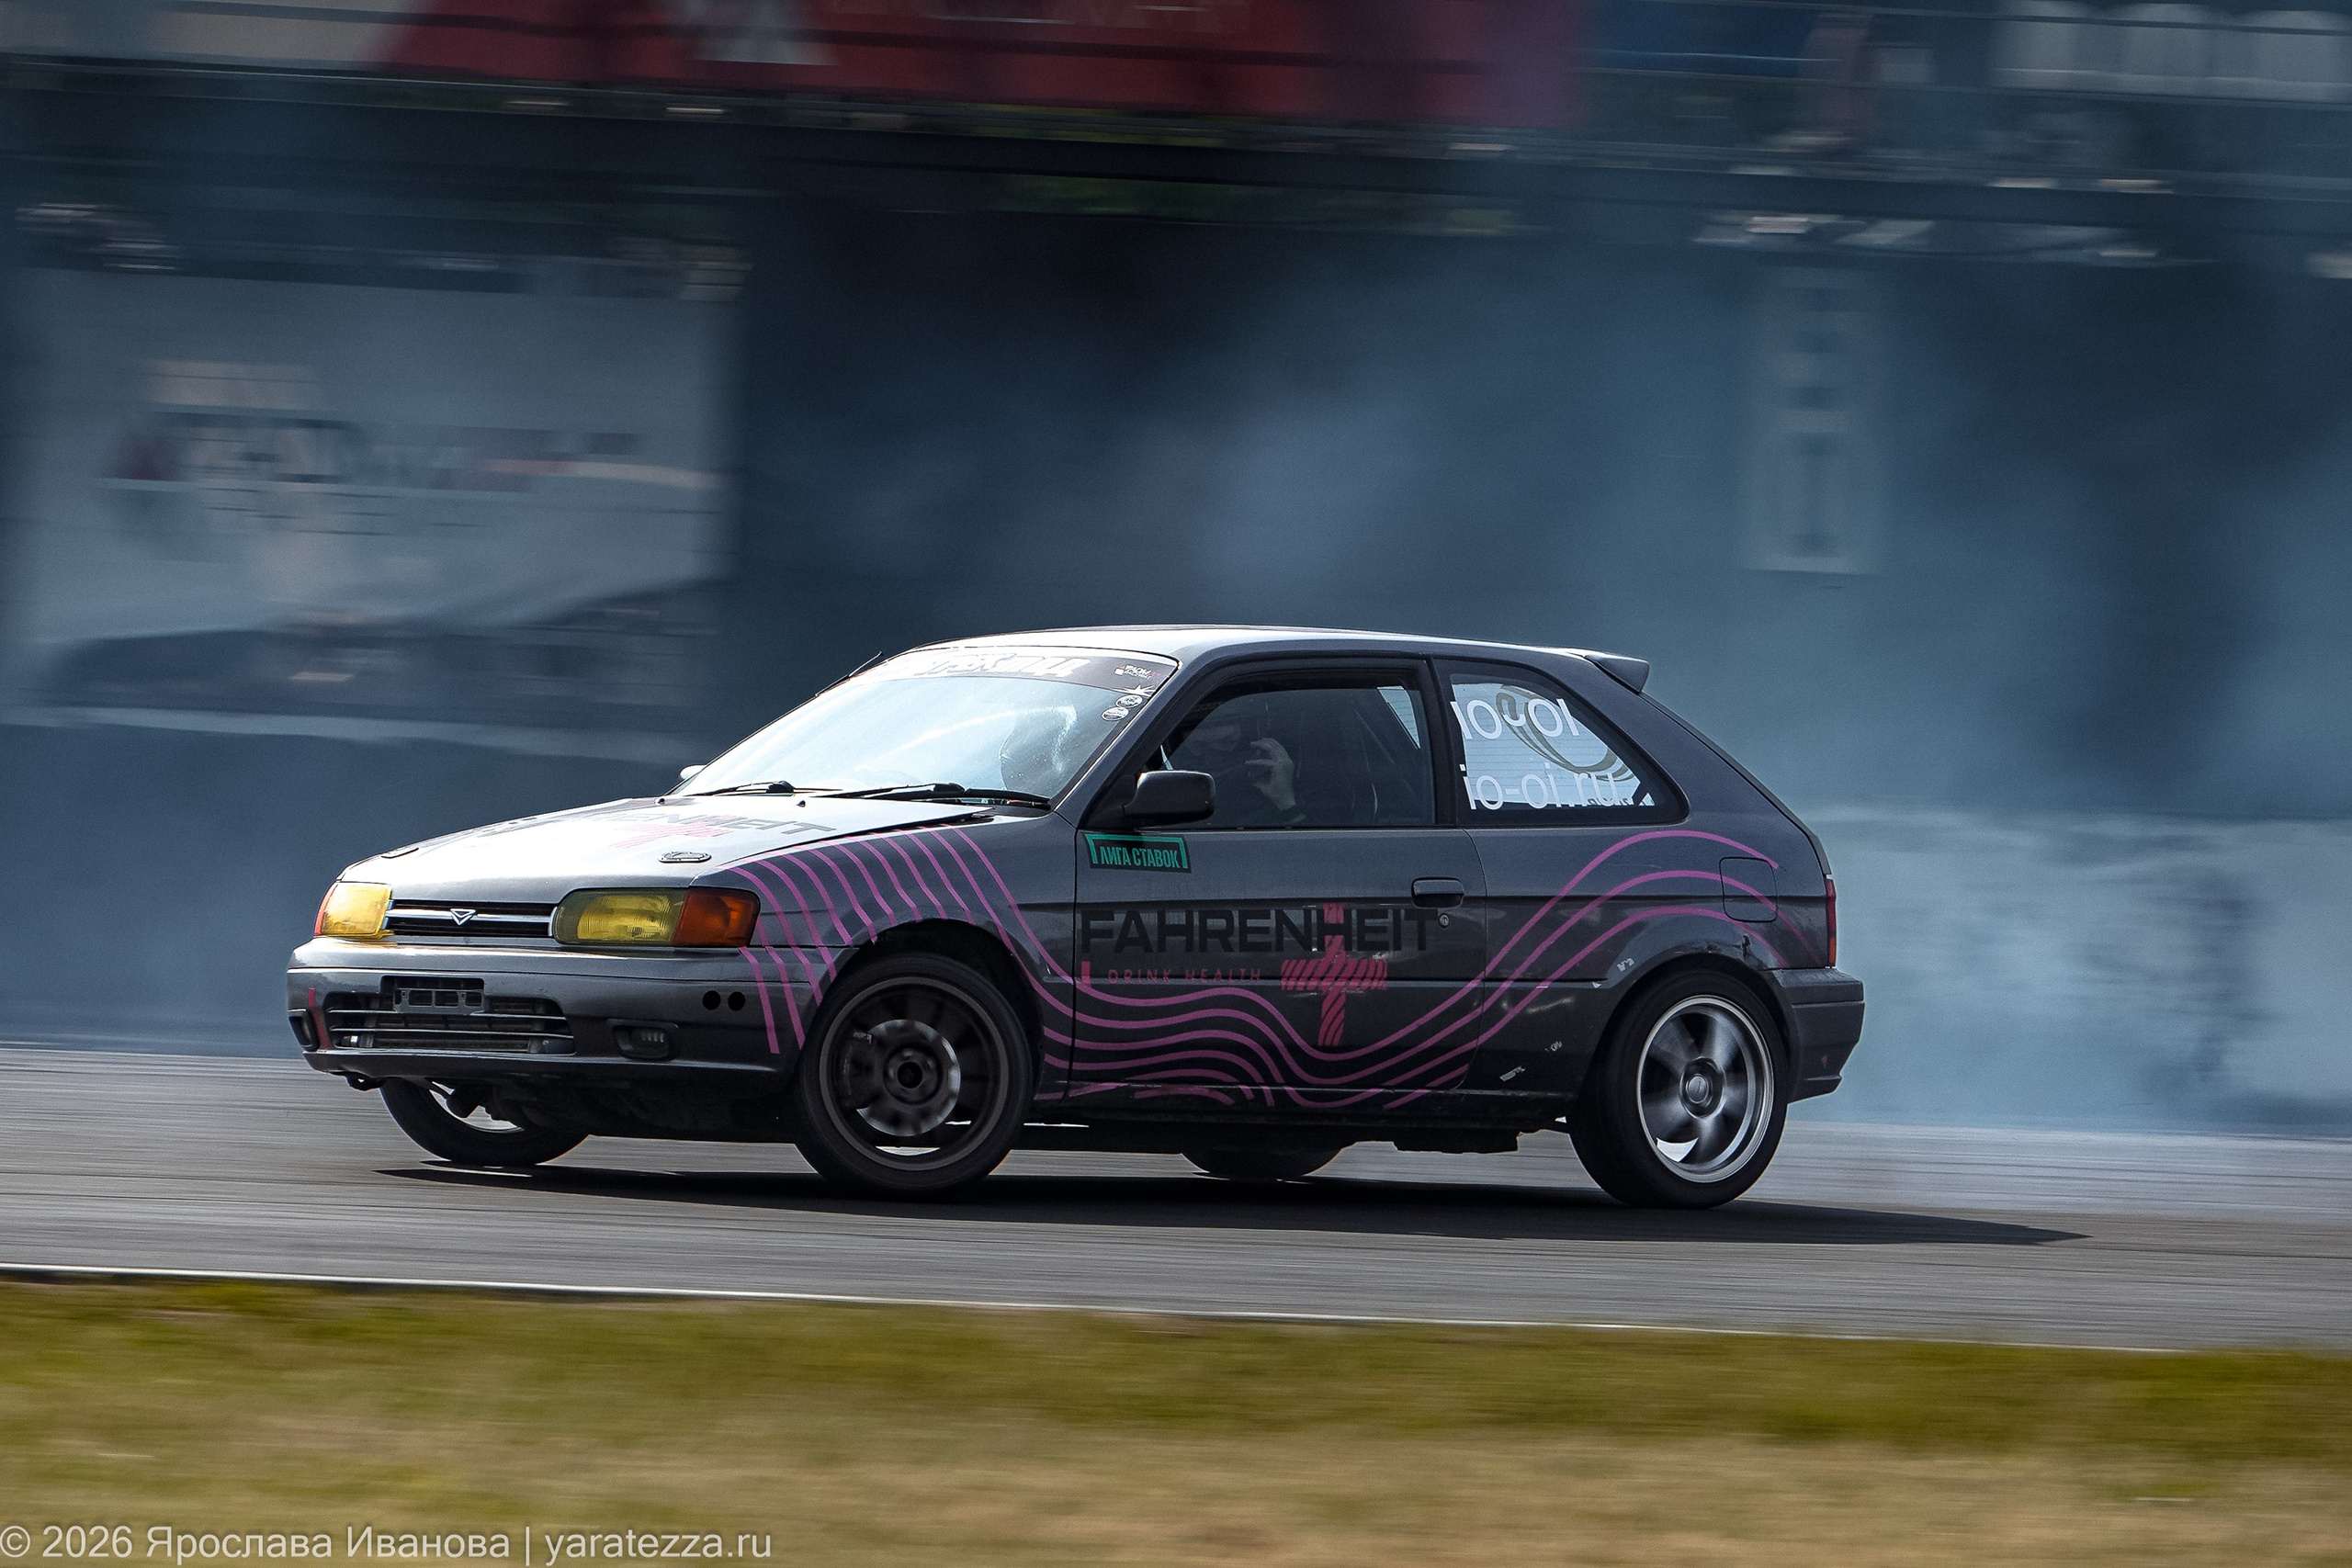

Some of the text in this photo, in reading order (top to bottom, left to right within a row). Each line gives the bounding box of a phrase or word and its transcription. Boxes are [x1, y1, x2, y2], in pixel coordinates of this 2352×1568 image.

[1100, 846, 1181, 869] ЛИГА СТАВОК
[1080, 908, 1439, 953] FAHRENHEIT
[1107, 968, 1261, 984] DRINK HEALTH
